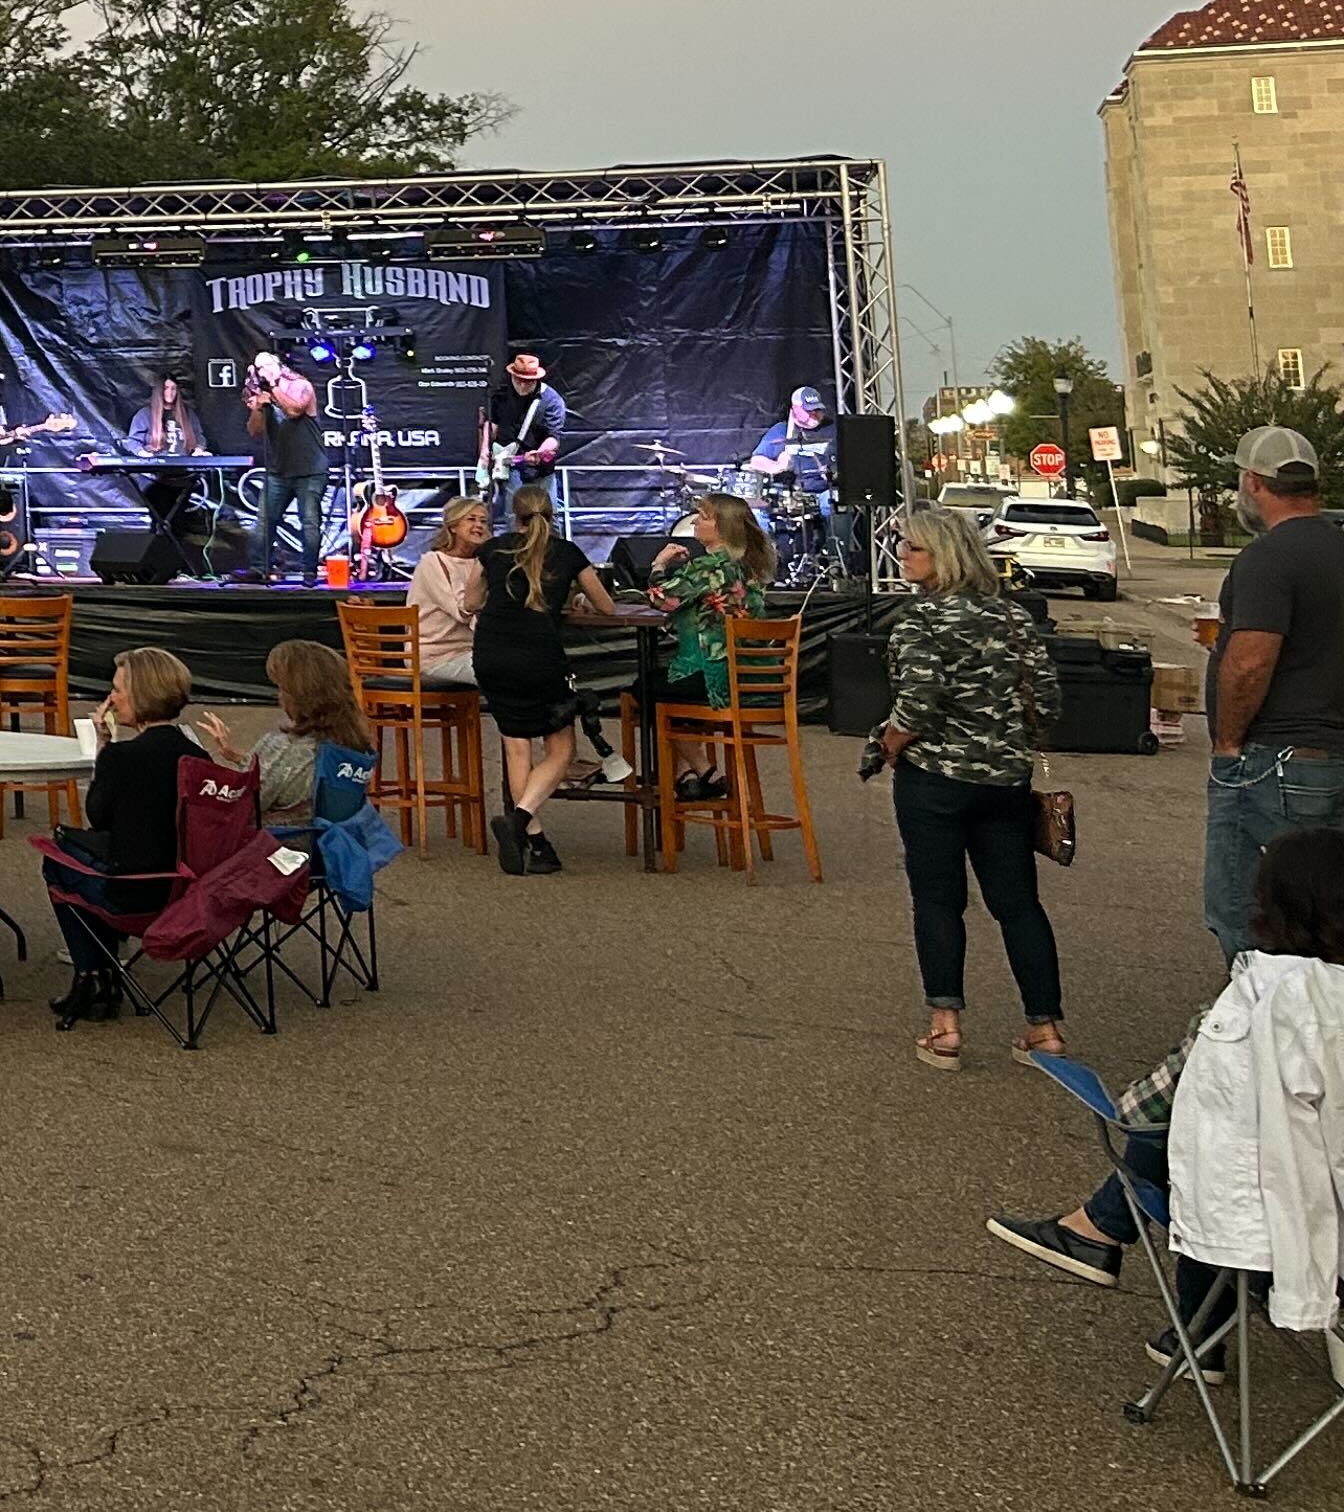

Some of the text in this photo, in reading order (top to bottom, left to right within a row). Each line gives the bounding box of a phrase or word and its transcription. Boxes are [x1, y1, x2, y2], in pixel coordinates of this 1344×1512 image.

[206, 263, 490, 313] TROPHY HUSBAND
[397, 430, 440, 447] USA
[1033, 453, 1063, 466] STOP
